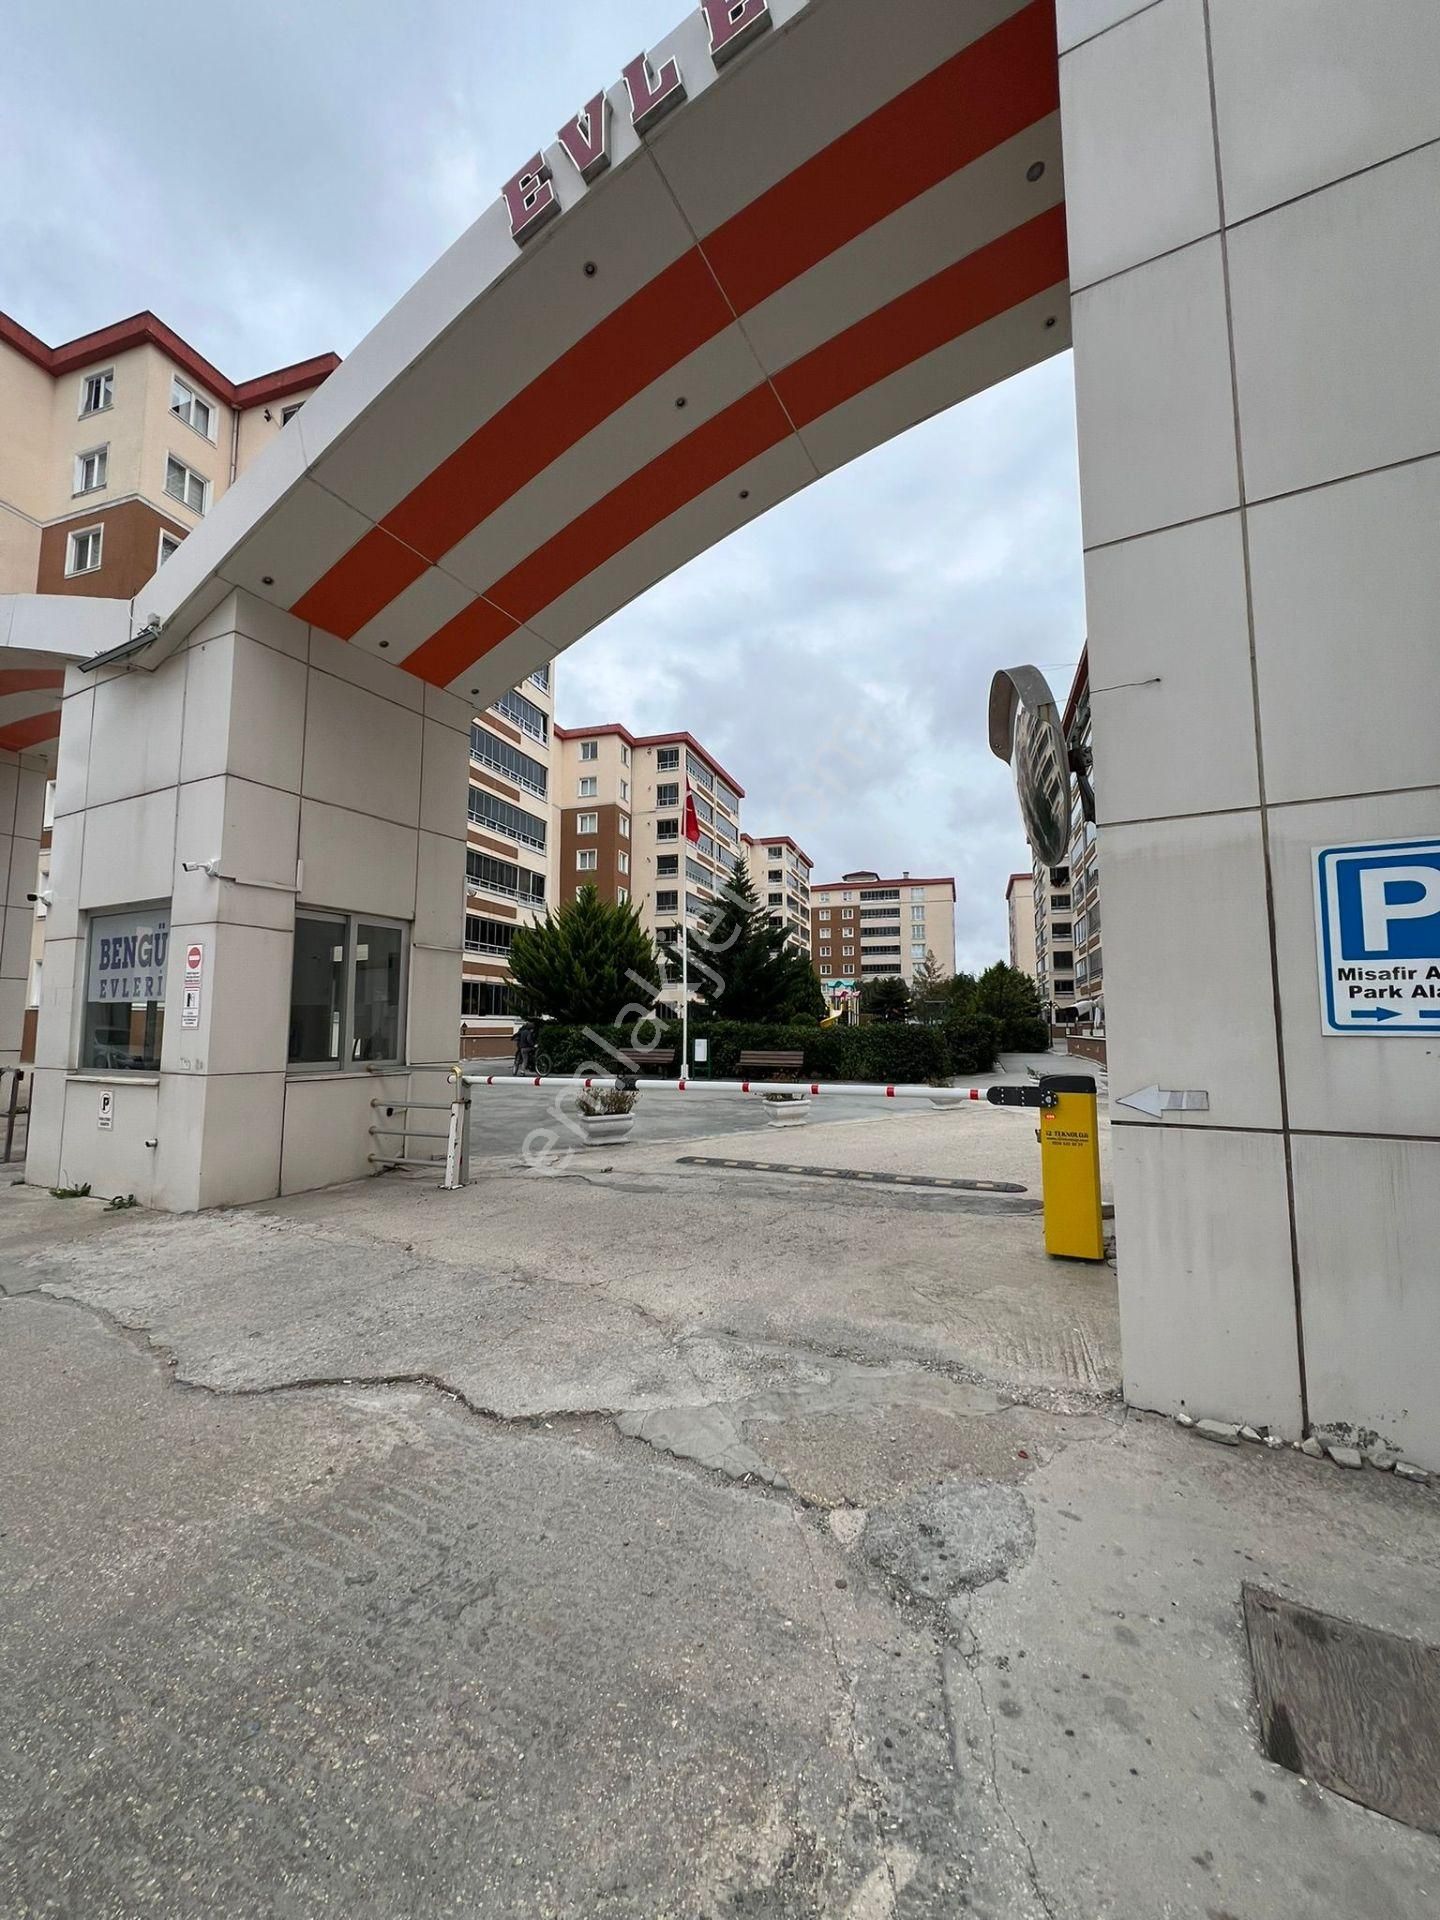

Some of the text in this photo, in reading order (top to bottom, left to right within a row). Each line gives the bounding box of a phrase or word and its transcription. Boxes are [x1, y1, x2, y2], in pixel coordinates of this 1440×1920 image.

[1359, 865, 1440, 952] P
[99, 922, 169, 970] BENGÜ
[100, 969, 164, 998] EVLERİ
[1337, 966, 1418, 981] Misafir
[1348, 984, 1403, 999] Park
